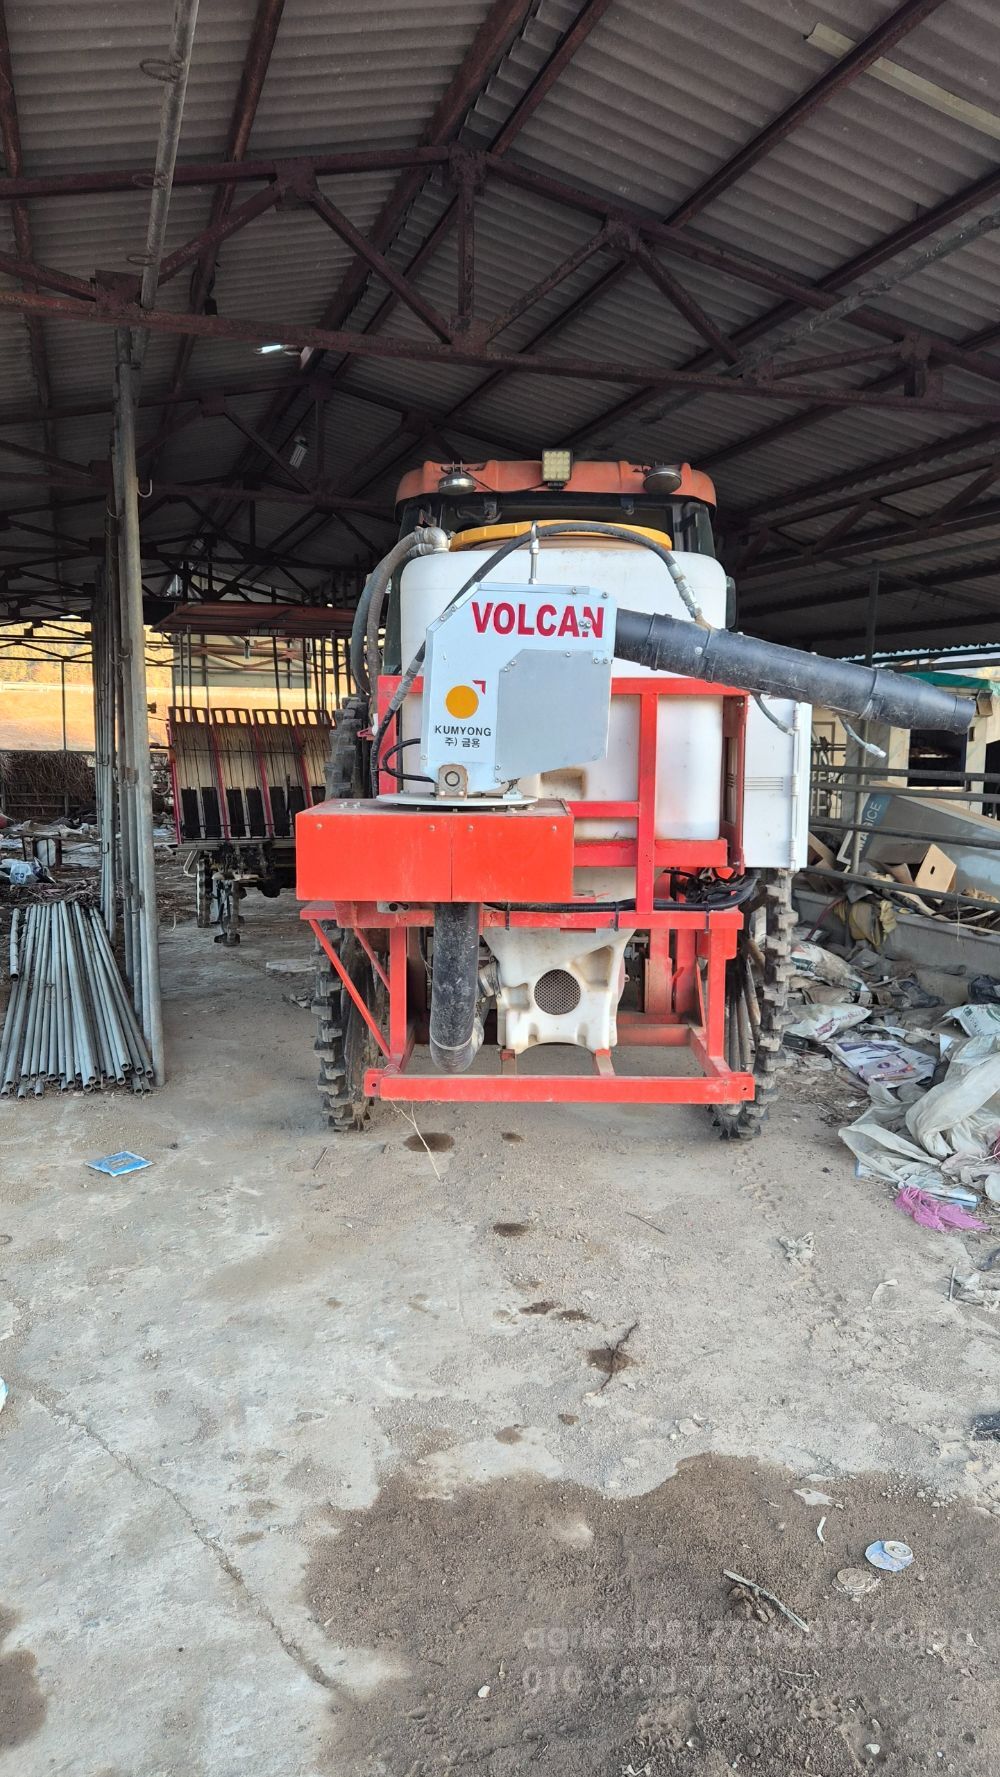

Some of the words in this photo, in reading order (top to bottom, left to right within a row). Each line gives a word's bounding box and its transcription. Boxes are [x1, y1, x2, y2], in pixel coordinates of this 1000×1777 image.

[472, 602, 604, 638] VOLCAN
[434, 725, 492, 736] KUMYONG
[461, 737, 481, 749] 금용
